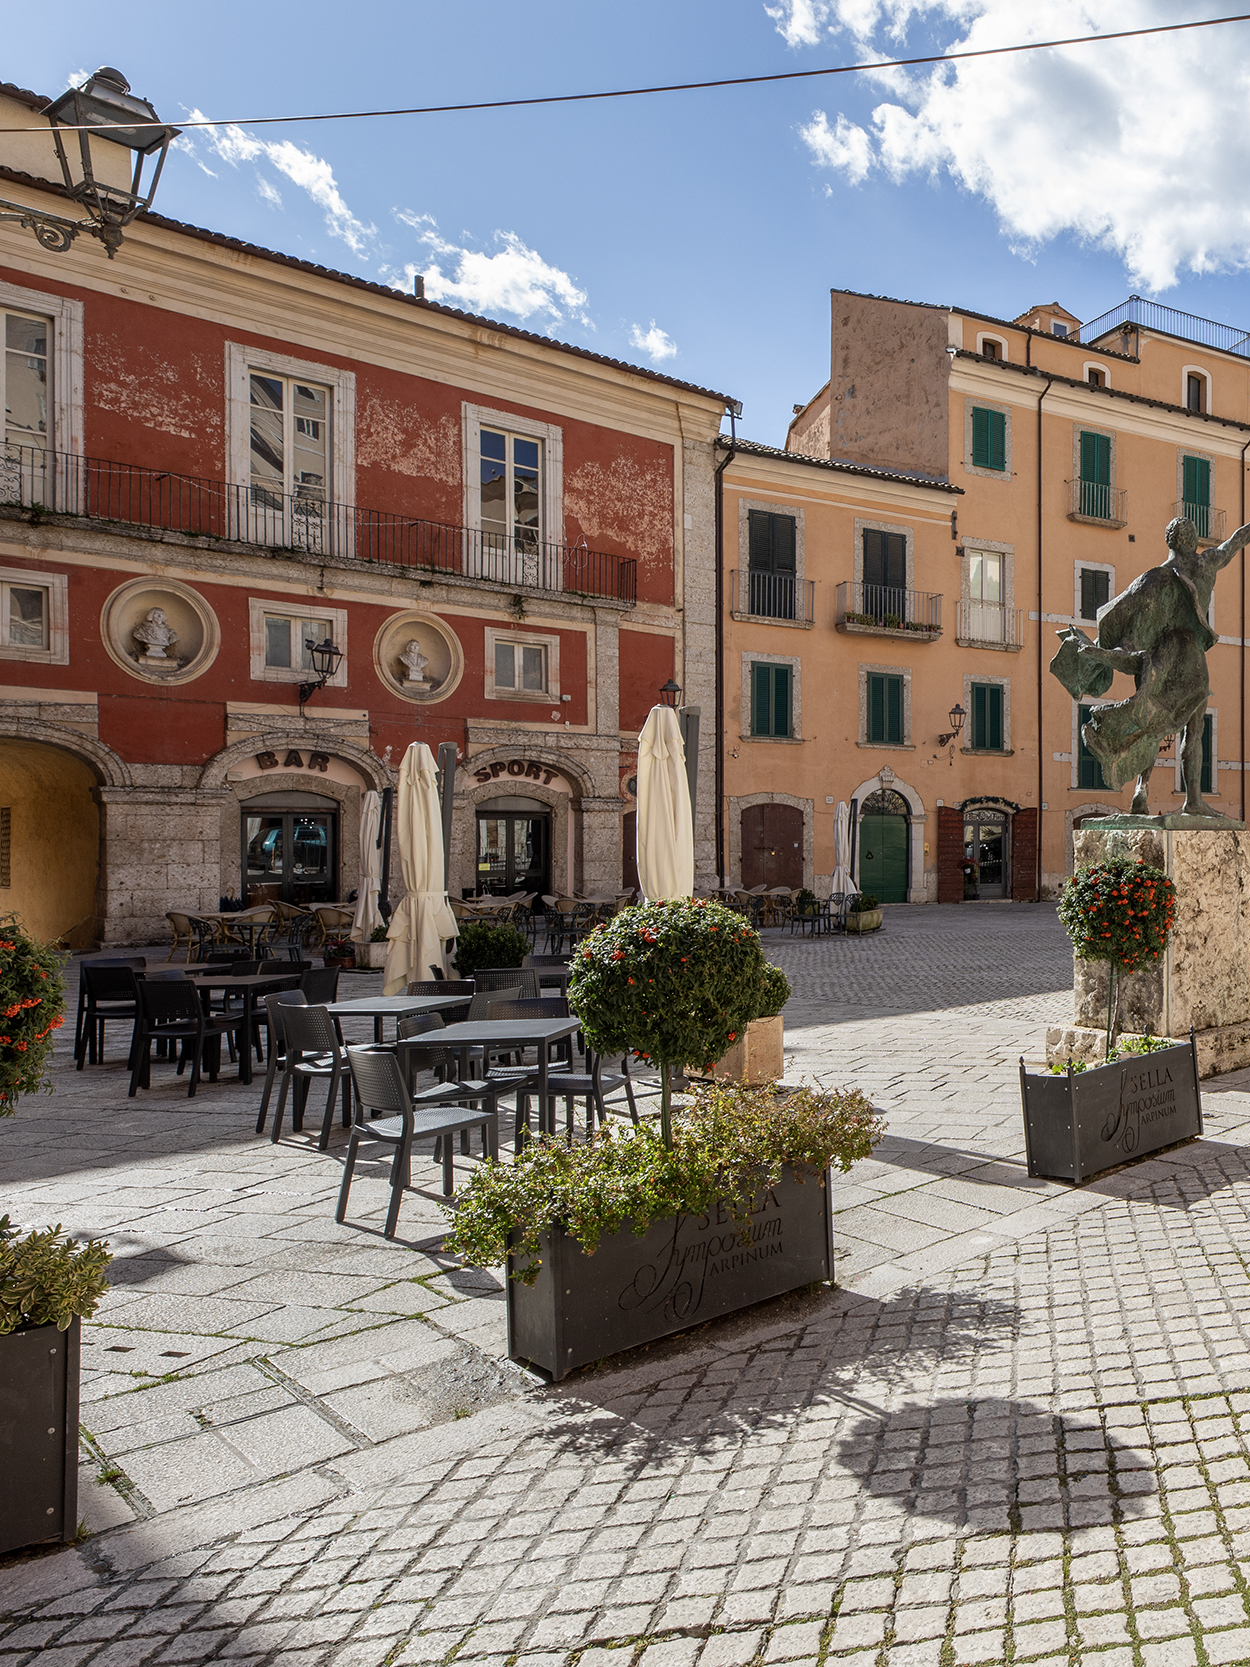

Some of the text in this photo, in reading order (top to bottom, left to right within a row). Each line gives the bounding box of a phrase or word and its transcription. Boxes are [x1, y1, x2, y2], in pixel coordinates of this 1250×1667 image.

[256, 750, 559, 786] BAR SPORT
[1130, 1066, 1174, 1094] SELLA
[1101, 1068, 1176, 1154] Symposium
[1141, 1104, 1178, 1126] ARPINUM
[708, 1240, 784, 1277] ARPINUM
